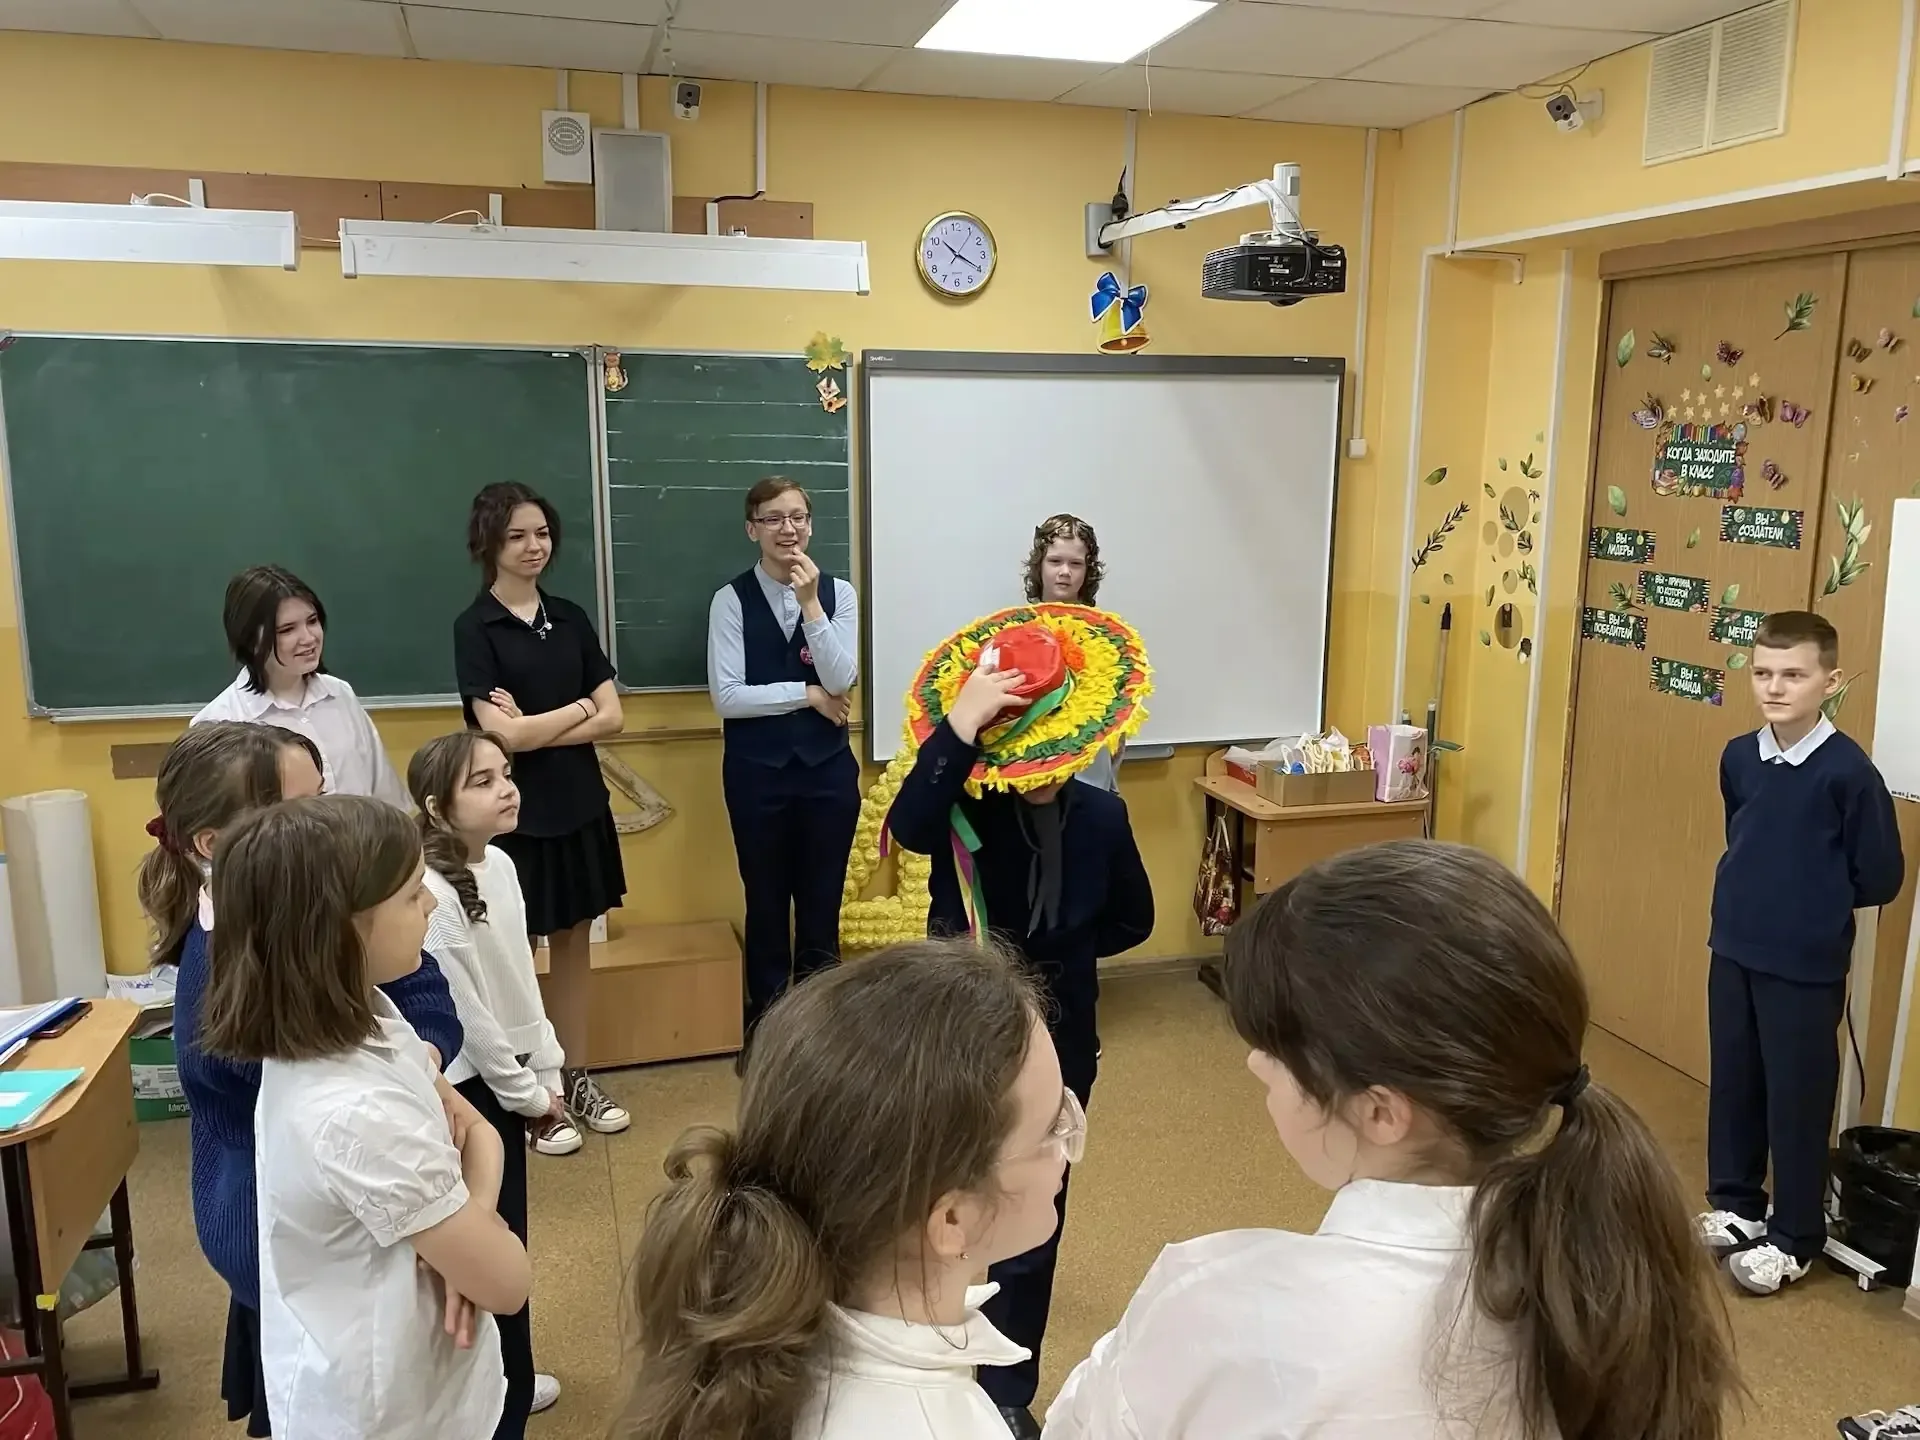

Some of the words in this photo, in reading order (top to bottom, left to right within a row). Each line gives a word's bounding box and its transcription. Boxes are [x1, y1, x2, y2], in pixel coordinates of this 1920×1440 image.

[941, 227, 948, 235] 11
[951, 222, 961, 232] 12
[930, 237, 940, 246] 10
[975, 236, 982, 246] 2
[926, 250, 933, 259] 9
[979, 250, 986, 259] 3
[931, 264, 938, 274] 8
[942, 274, 948, 283] 7
[954, 278, 960, 287] 6
[967, 275, 974, 284] 5
[1666, 446, 1692, 462] КОГДА
[1694, 447, 1736, 464] ЗАХОДИТЕ
[1680, 463, 1688, 478] В
[1688, 464, 1716, 480] КЛАСС
[1754, 512, 1770, 526] ВЫ
[1615, 531, 1628, 544] ВЫ
[1738, 524, 1784, 540] СОЗДАТЕЛИ
[1606, 543, 1635, 557] ЛИДЕРЫ
[1654, 574, 1665, 584] ВЫ
[1655, 585, 1664, 595] ПО
[1664, 586, 1689, 599] КОТОРОЙ
[1659, 595, 1665, 605] Я
[1608, 613, 1621, 626] ВЫ
[1743, 614, 1758, 629] ВЫ
[1593, 622, 1633, 640] ПОБЕДИТЕЛИ
[1680, 667, 1693, 680] ВЫ
[1669, 677, 1702, 695] КОМАНДА
